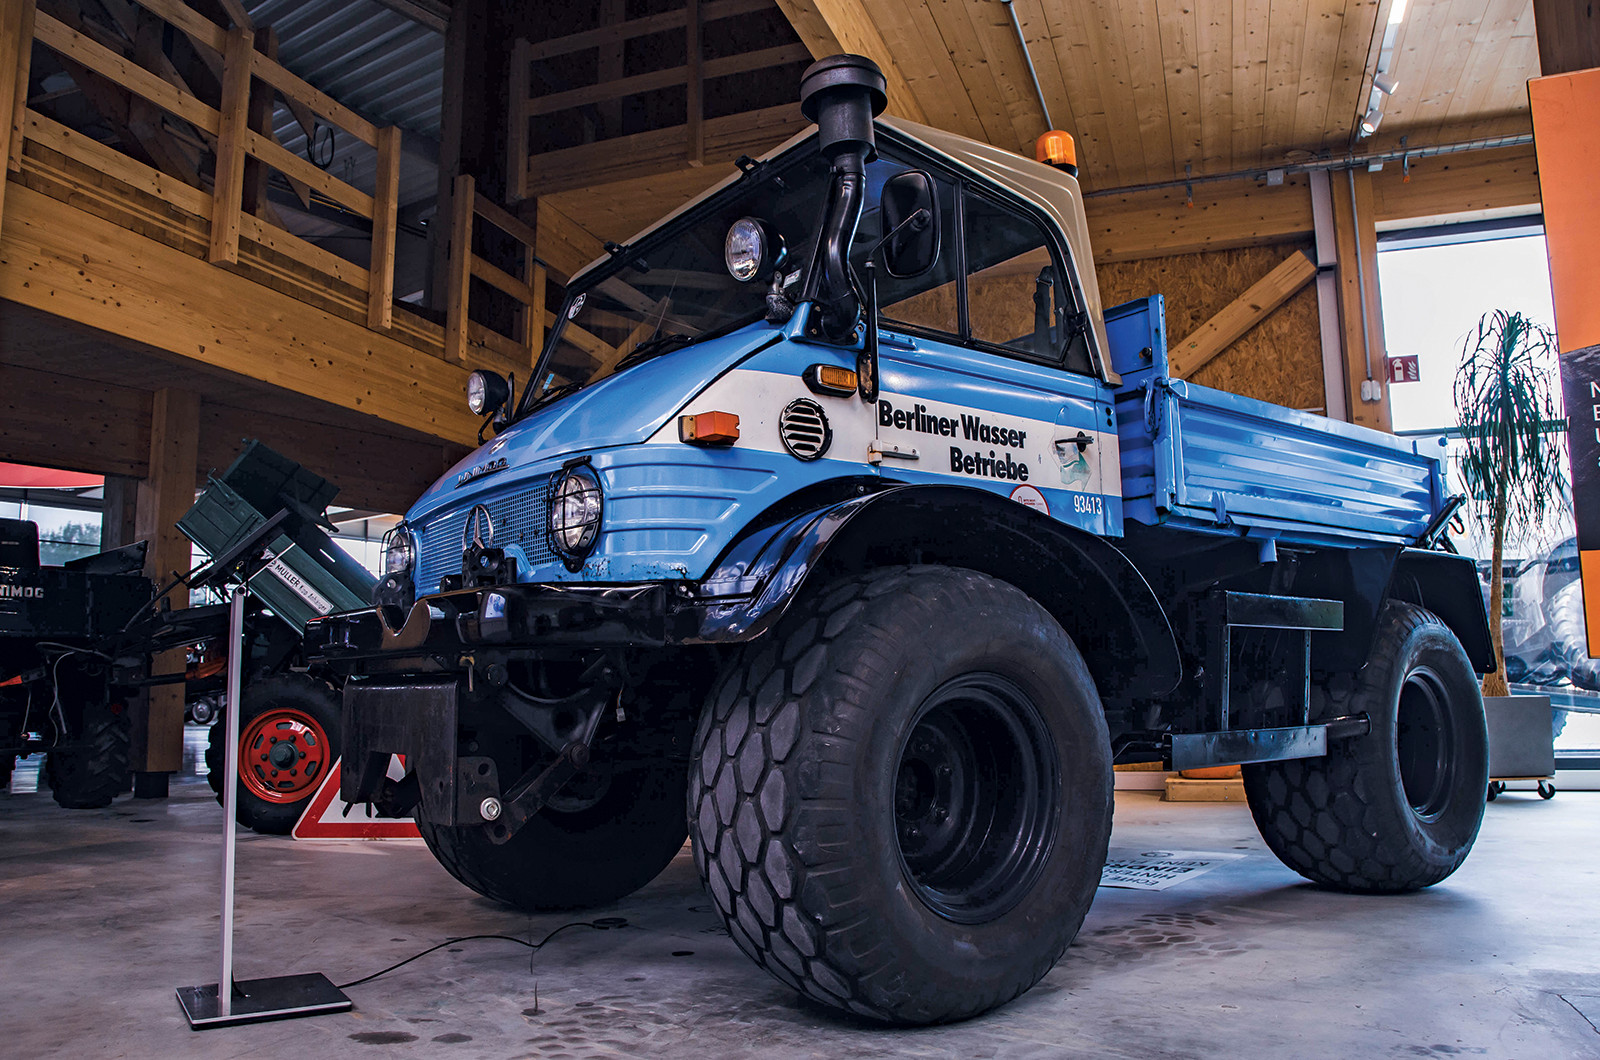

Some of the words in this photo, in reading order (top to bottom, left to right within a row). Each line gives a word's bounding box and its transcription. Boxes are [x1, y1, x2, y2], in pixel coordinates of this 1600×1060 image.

[878, 399, 958, 438] Berliner
[960, 413, 1027, 449] Wasser
[949, 446, 1029, 482] Betriebe
[1073, 494, 1102, 515] 93413
